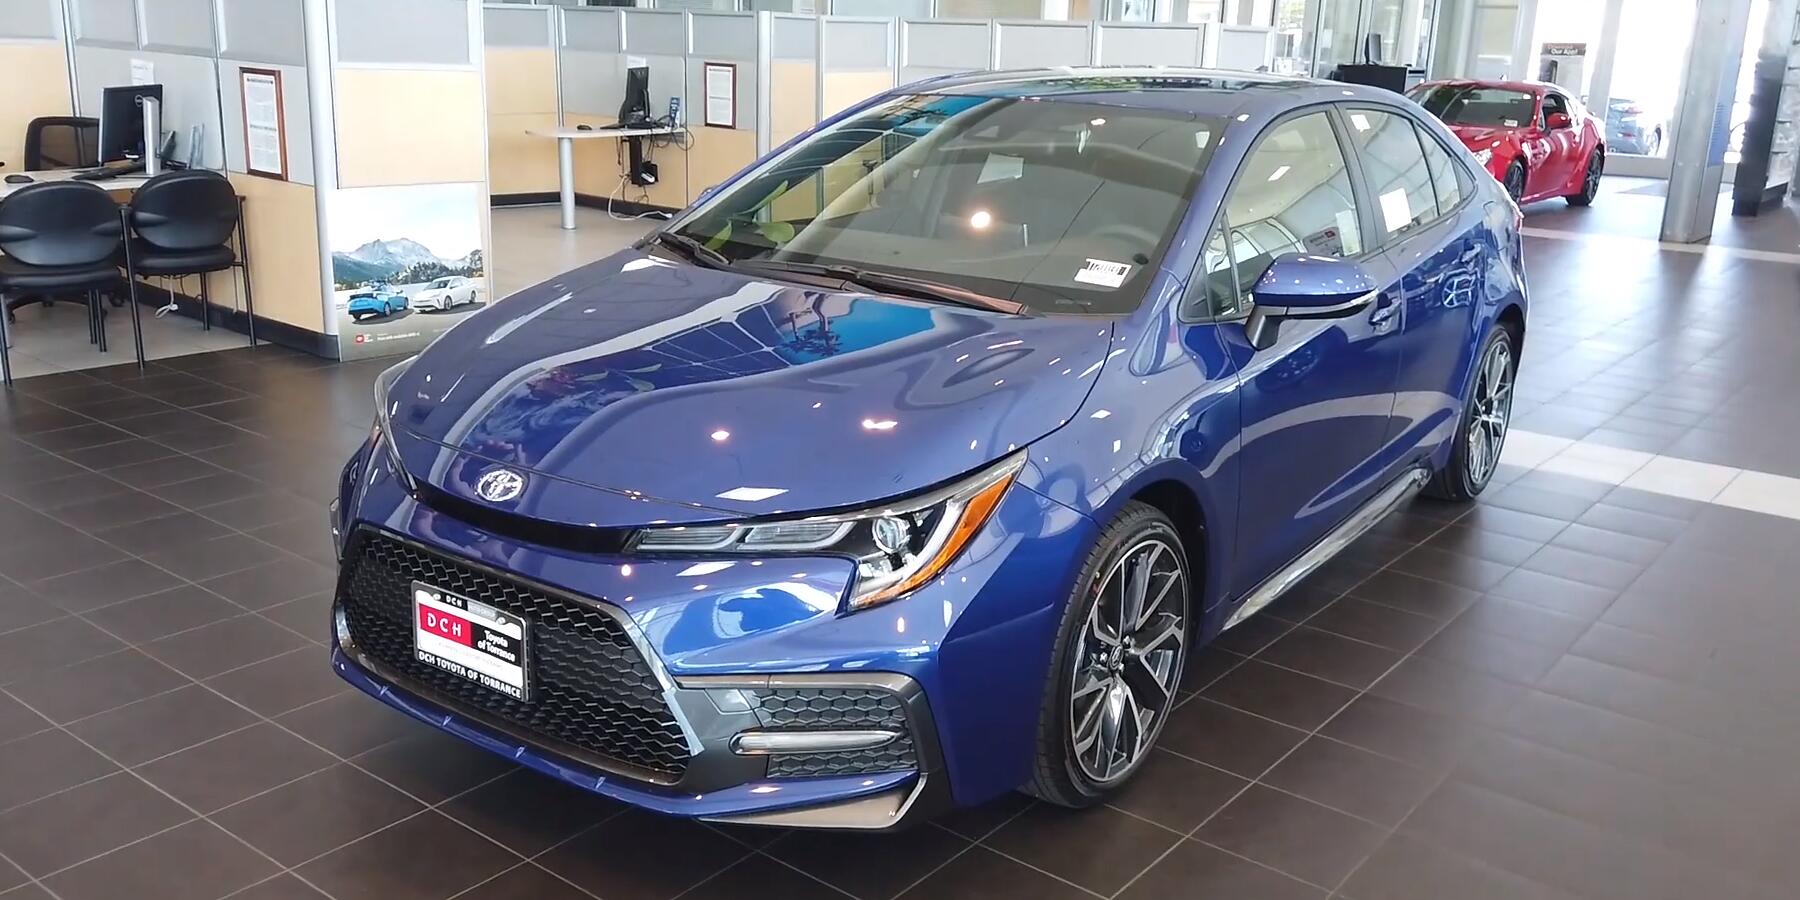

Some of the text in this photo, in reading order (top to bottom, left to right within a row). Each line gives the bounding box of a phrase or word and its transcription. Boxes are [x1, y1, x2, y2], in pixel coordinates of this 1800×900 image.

[446, 595, 462, 607] DCH
[427, 612, 462, 637] DCH
[484, 629, 509, 648] Toyota
[477, 640, 486, 650] of
[486, 642, 516, 662] Torrance
[419, 651, 435, 664] DCH
[436, 657, 467, 677] TOYOTA
[467, 669, 478, 680] OF
[479, 673, 522, 699] TORRANCE
